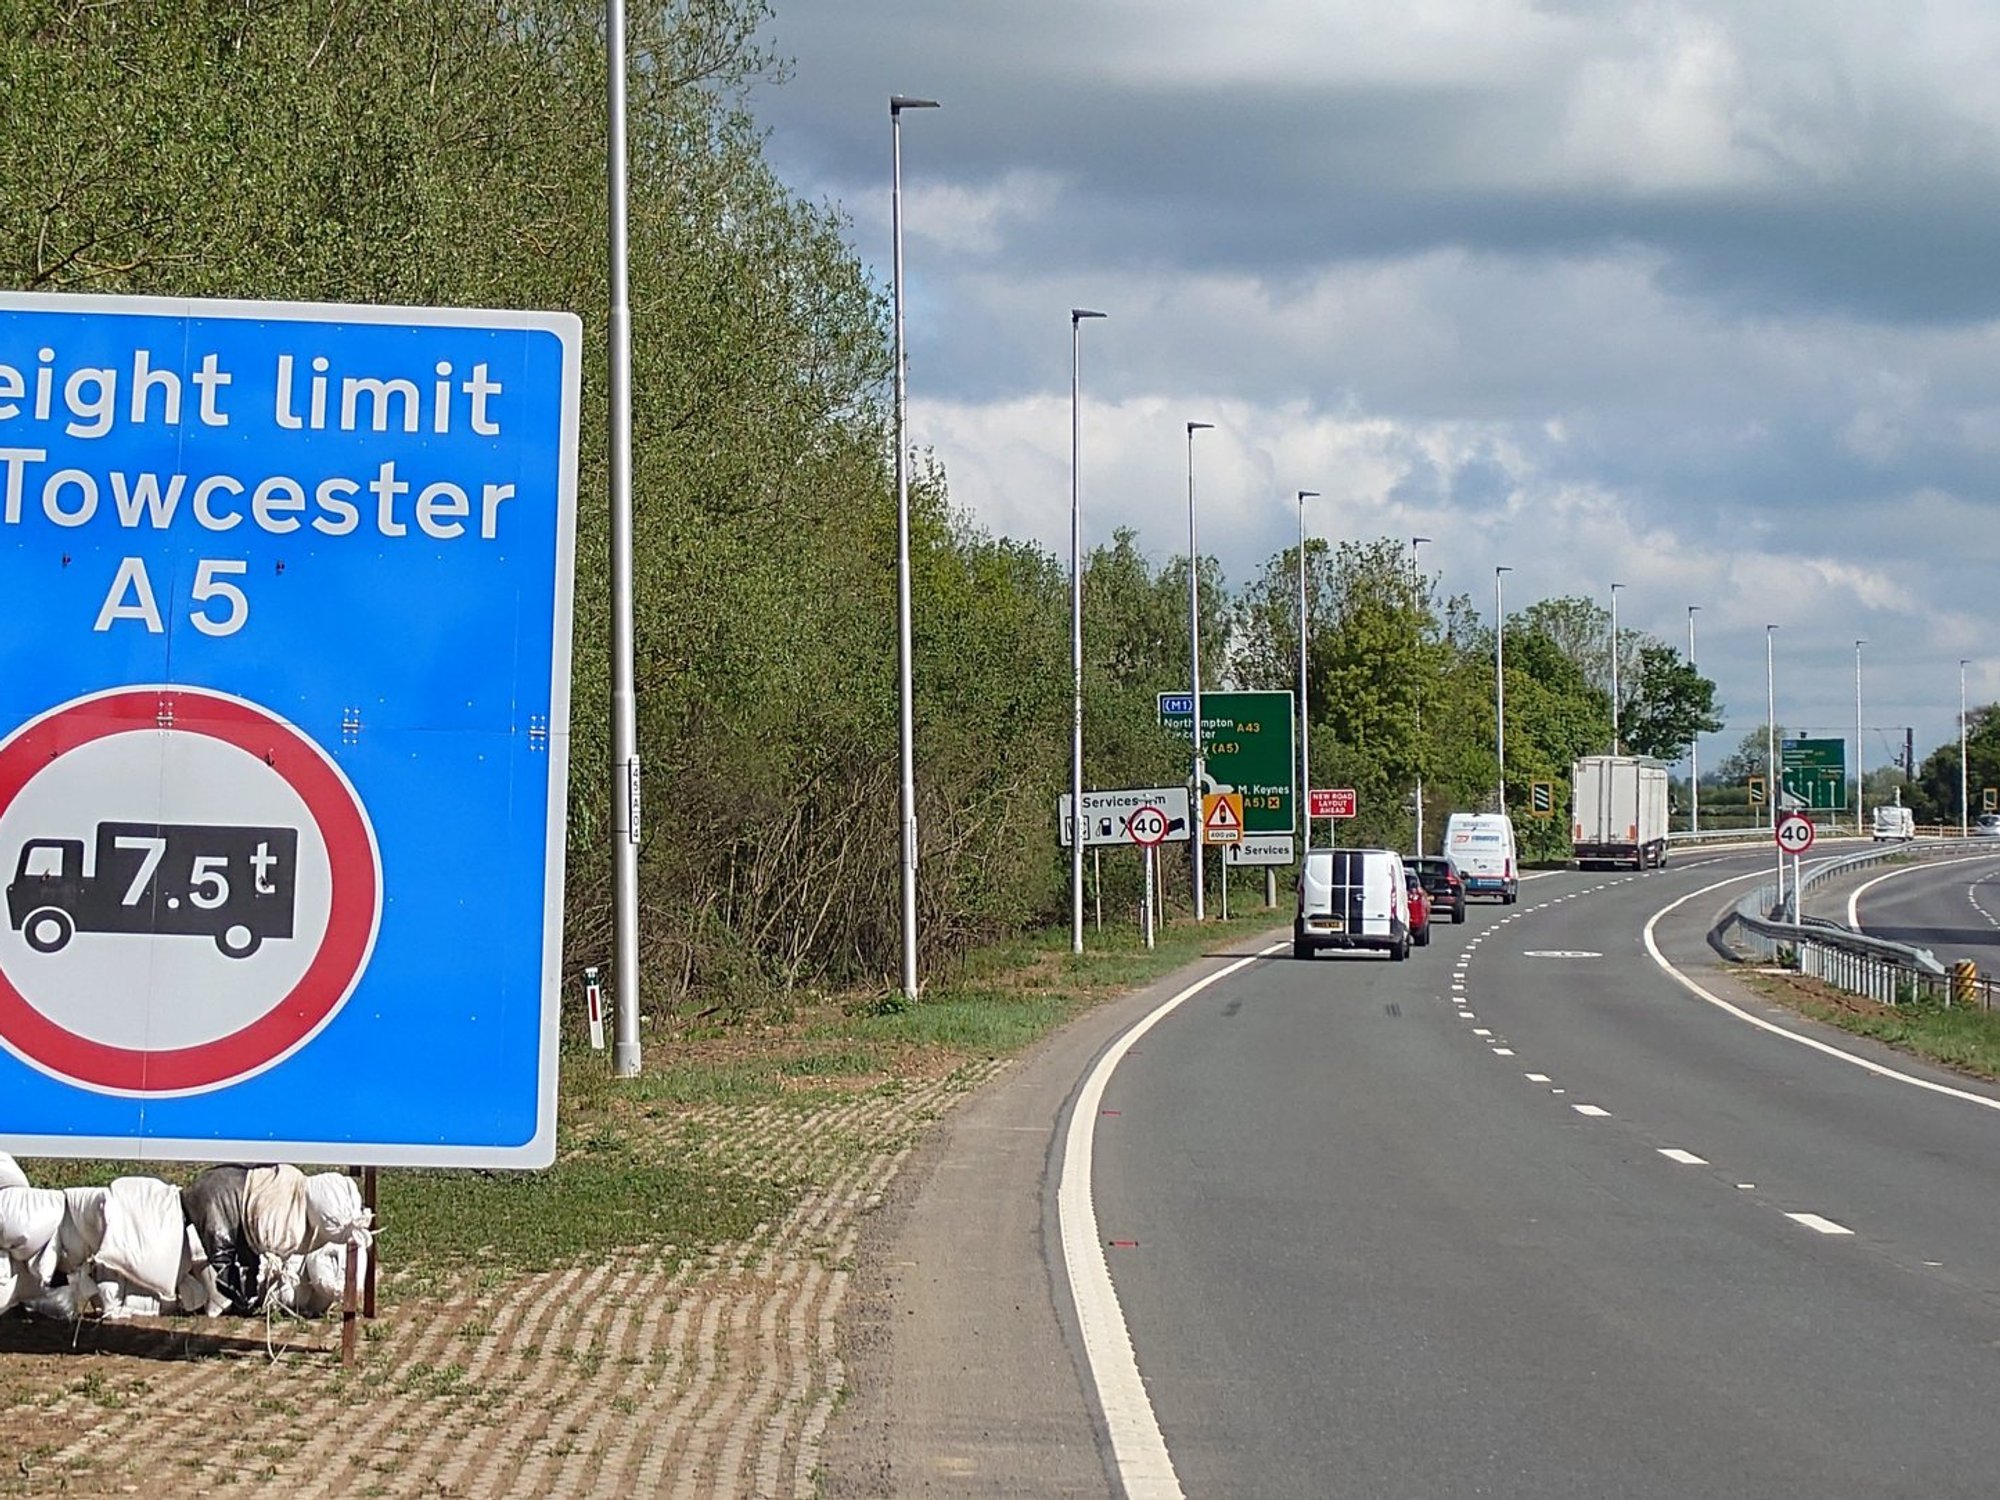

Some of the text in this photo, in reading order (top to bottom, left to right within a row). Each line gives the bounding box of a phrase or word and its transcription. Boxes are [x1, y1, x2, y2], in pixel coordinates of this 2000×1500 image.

[276, 355, 503, 435] limit
[0, 447, 515, 539] Towcester
[1165, 700, 1193, 711] (M1)
[1236, 722, 1261, 733] A43
[1211, 742, 1240, 754] (A5)
[1253, 784, 1290, 798] Keynes
[1332, 792, 1353, 800] ROAD
[1082, 795, 1139, 808] Services
[1244, 797, 1265, 809] A5)
[1134, 818, 1162, 834] 40
[1781, 825, 1809, 841] 40
[1244, 845, 1290, 856] Services
